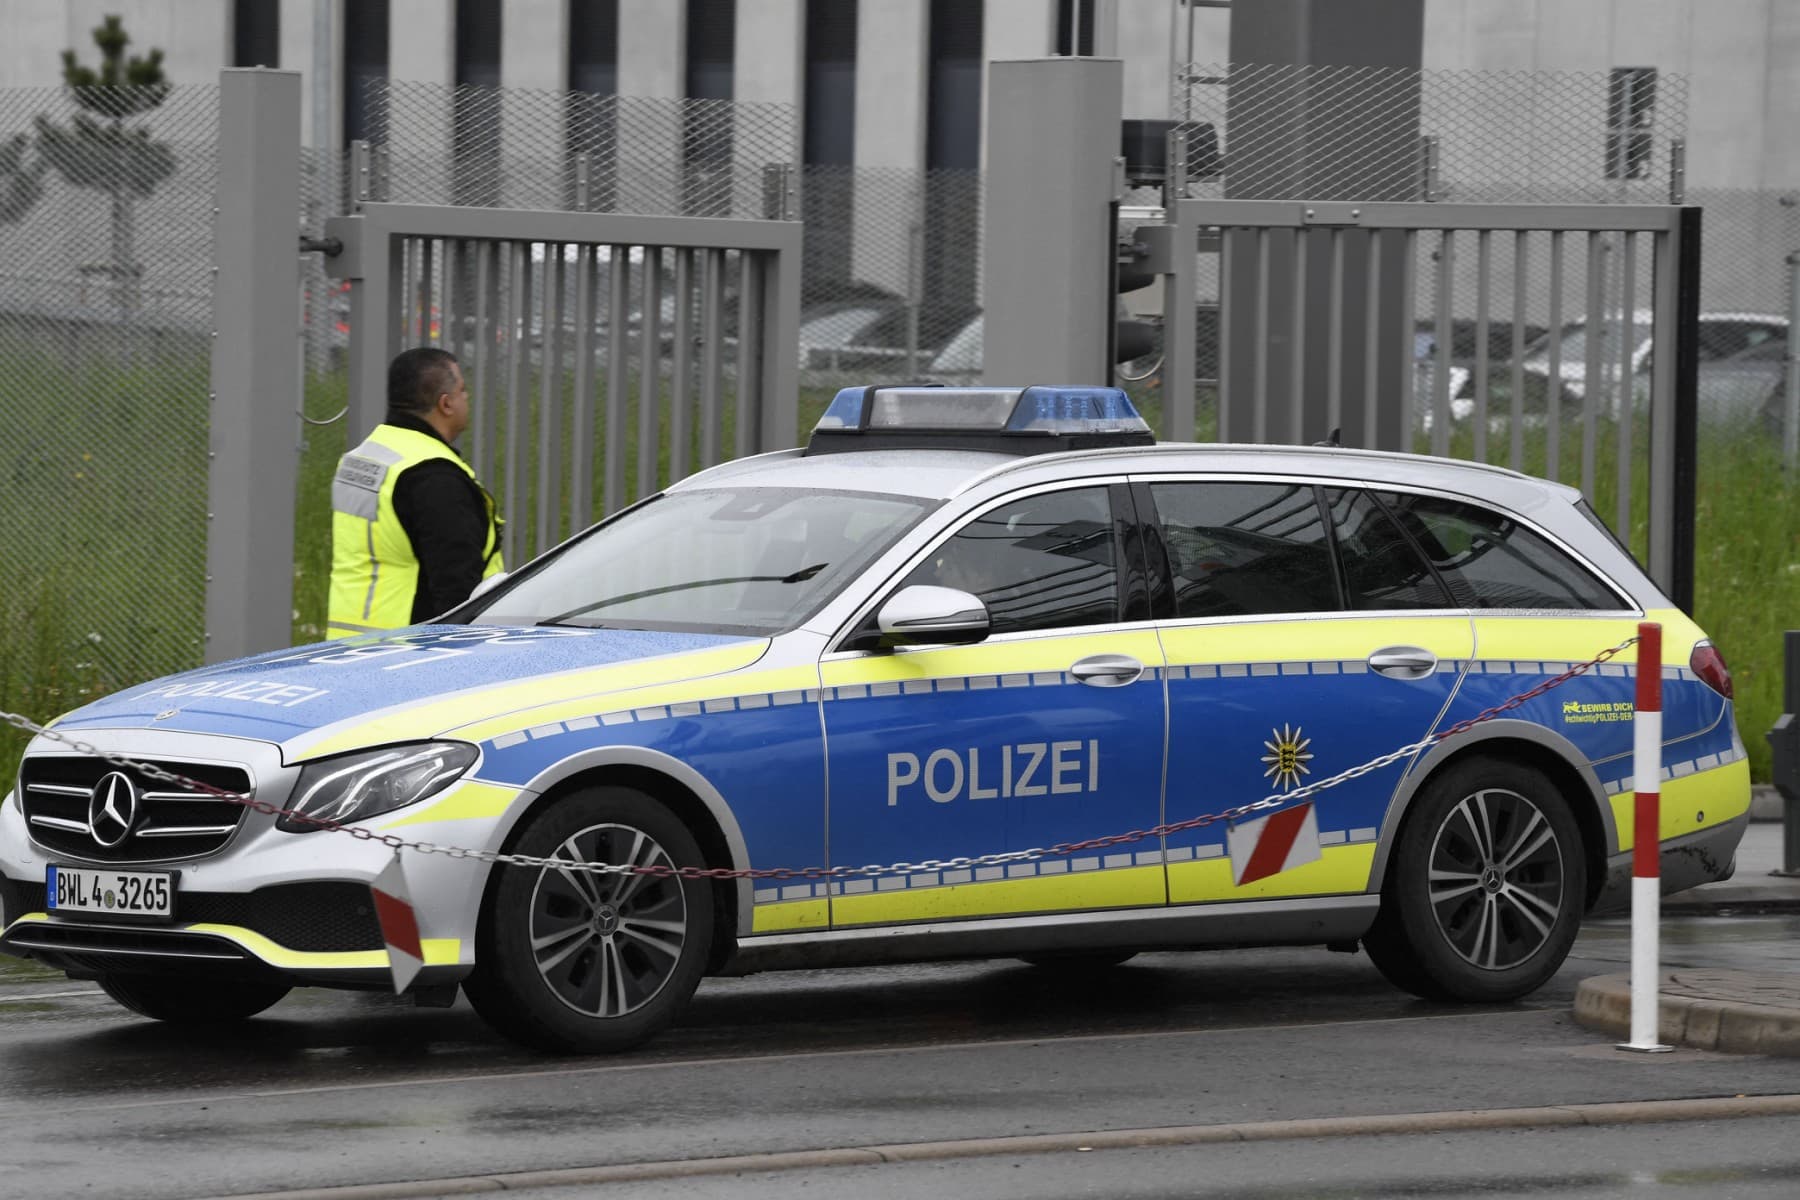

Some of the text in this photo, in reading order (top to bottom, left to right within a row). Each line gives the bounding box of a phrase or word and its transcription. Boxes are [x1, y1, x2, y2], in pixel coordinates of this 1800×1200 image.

[128, 681, 331, 707] POLIZEI
[1581, 703, 1634, 712] BEWIRB DICH
[887, 739, 1098, 806] POLIZEI
[57, 872, 168, 910] BWL 4 3265
